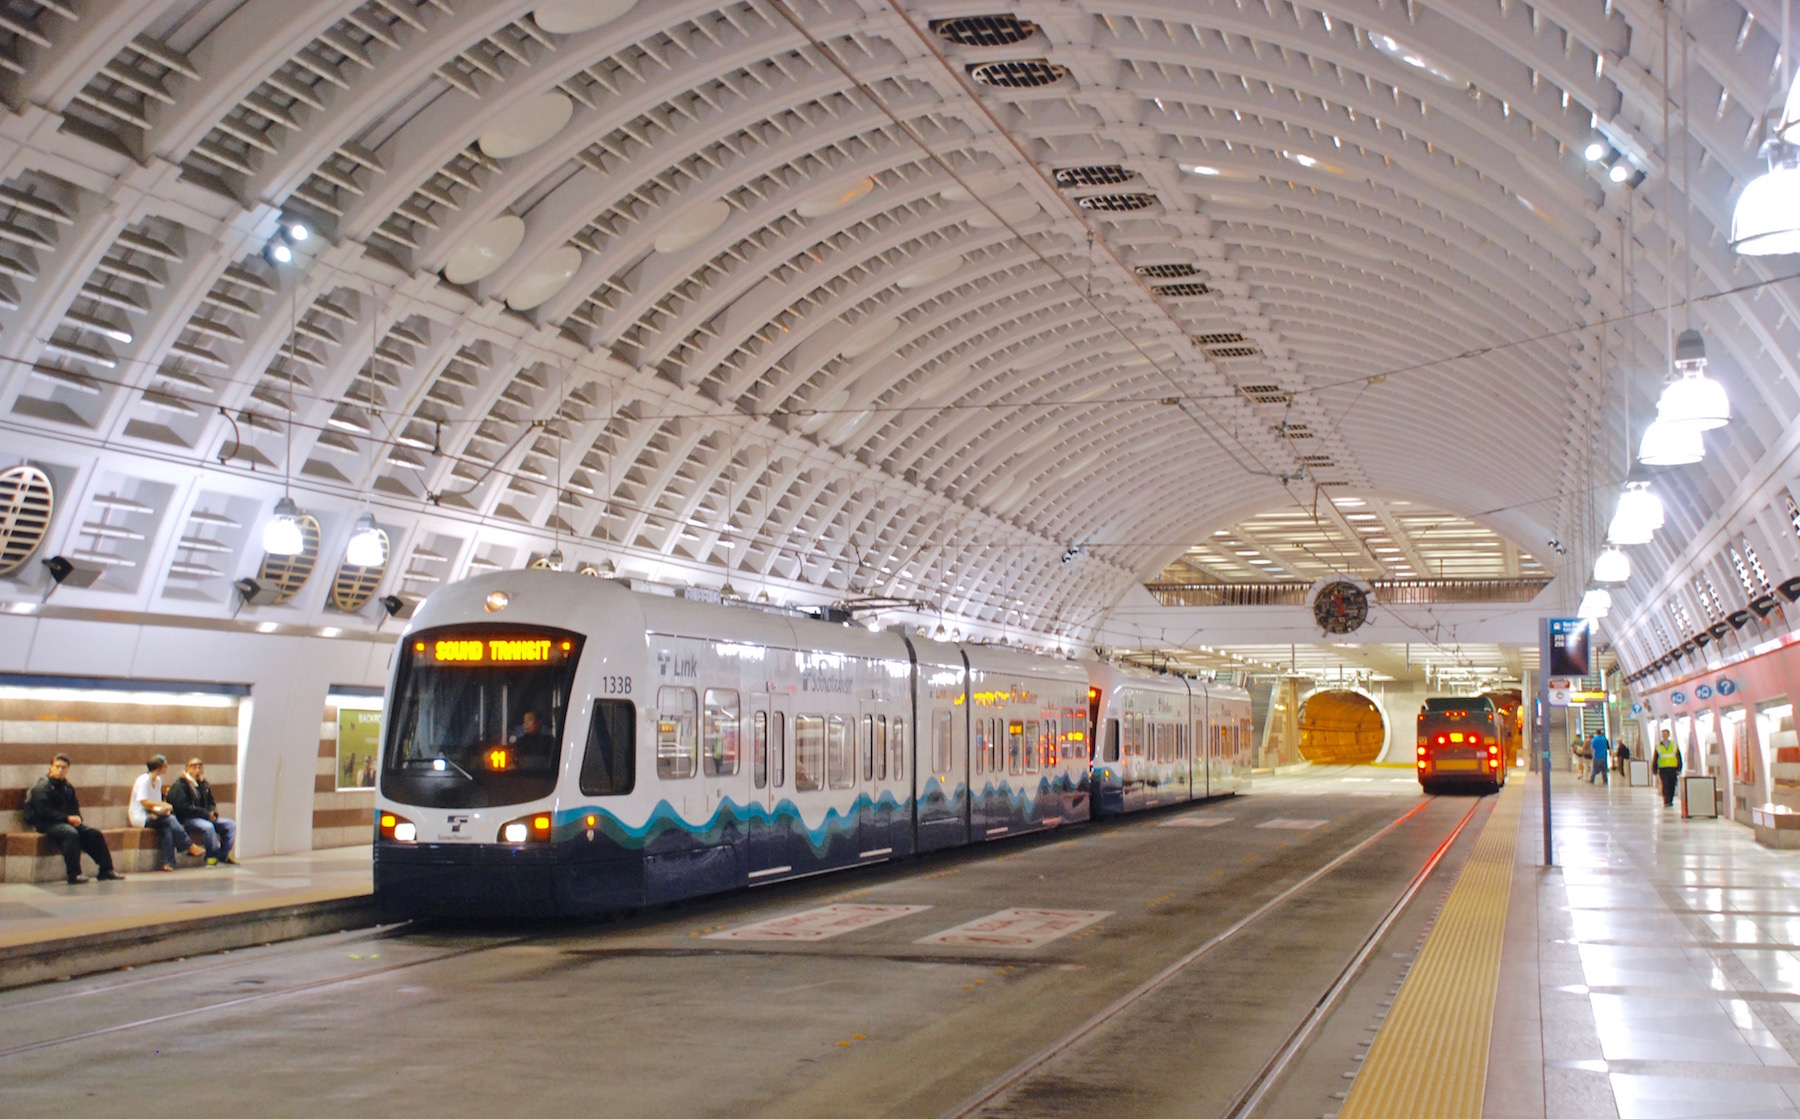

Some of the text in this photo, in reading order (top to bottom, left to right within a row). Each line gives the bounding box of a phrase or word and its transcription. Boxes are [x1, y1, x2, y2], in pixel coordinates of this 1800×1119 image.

[435, 641, 551, 660] SOUND TRANSIT
[674, 653, 697, 677] Link
[603, 676, 632, 694] 133B
[491, 751, 505, 767] 11
